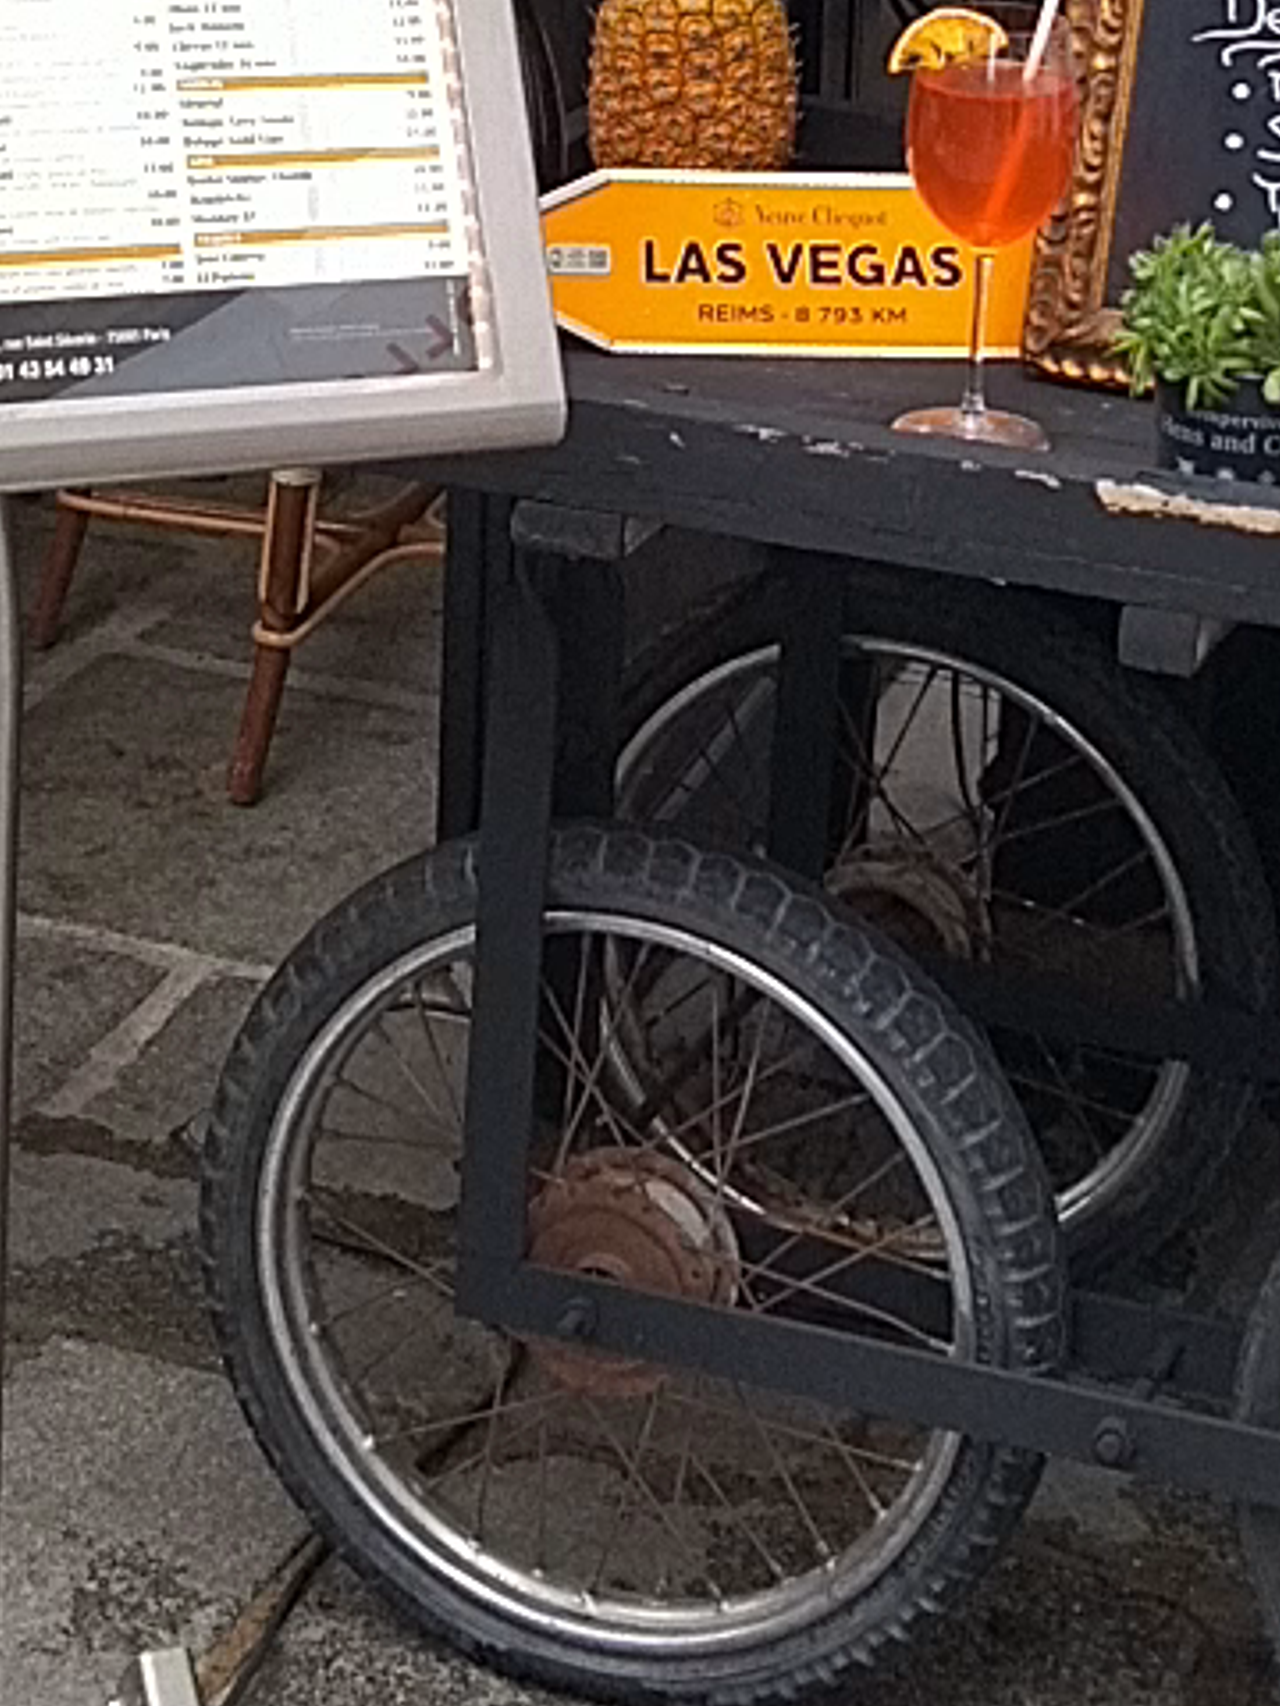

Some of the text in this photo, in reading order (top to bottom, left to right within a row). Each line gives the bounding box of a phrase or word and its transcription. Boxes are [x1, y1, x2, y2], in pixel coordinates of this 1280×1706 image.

[643, 241, 746, 284] LAS
[766, 241, 963, 287] VEGAS
[697, 303, 774, 323] REIMS
[795, 304, 811, 324] 8
[818, 305, 863, 325] 793
[872, 305, 908, 324] KM
[19, 359, 40, 379] 43
[94, 354, 114, 374] 31
[1210, 433, 1256, 455] and
